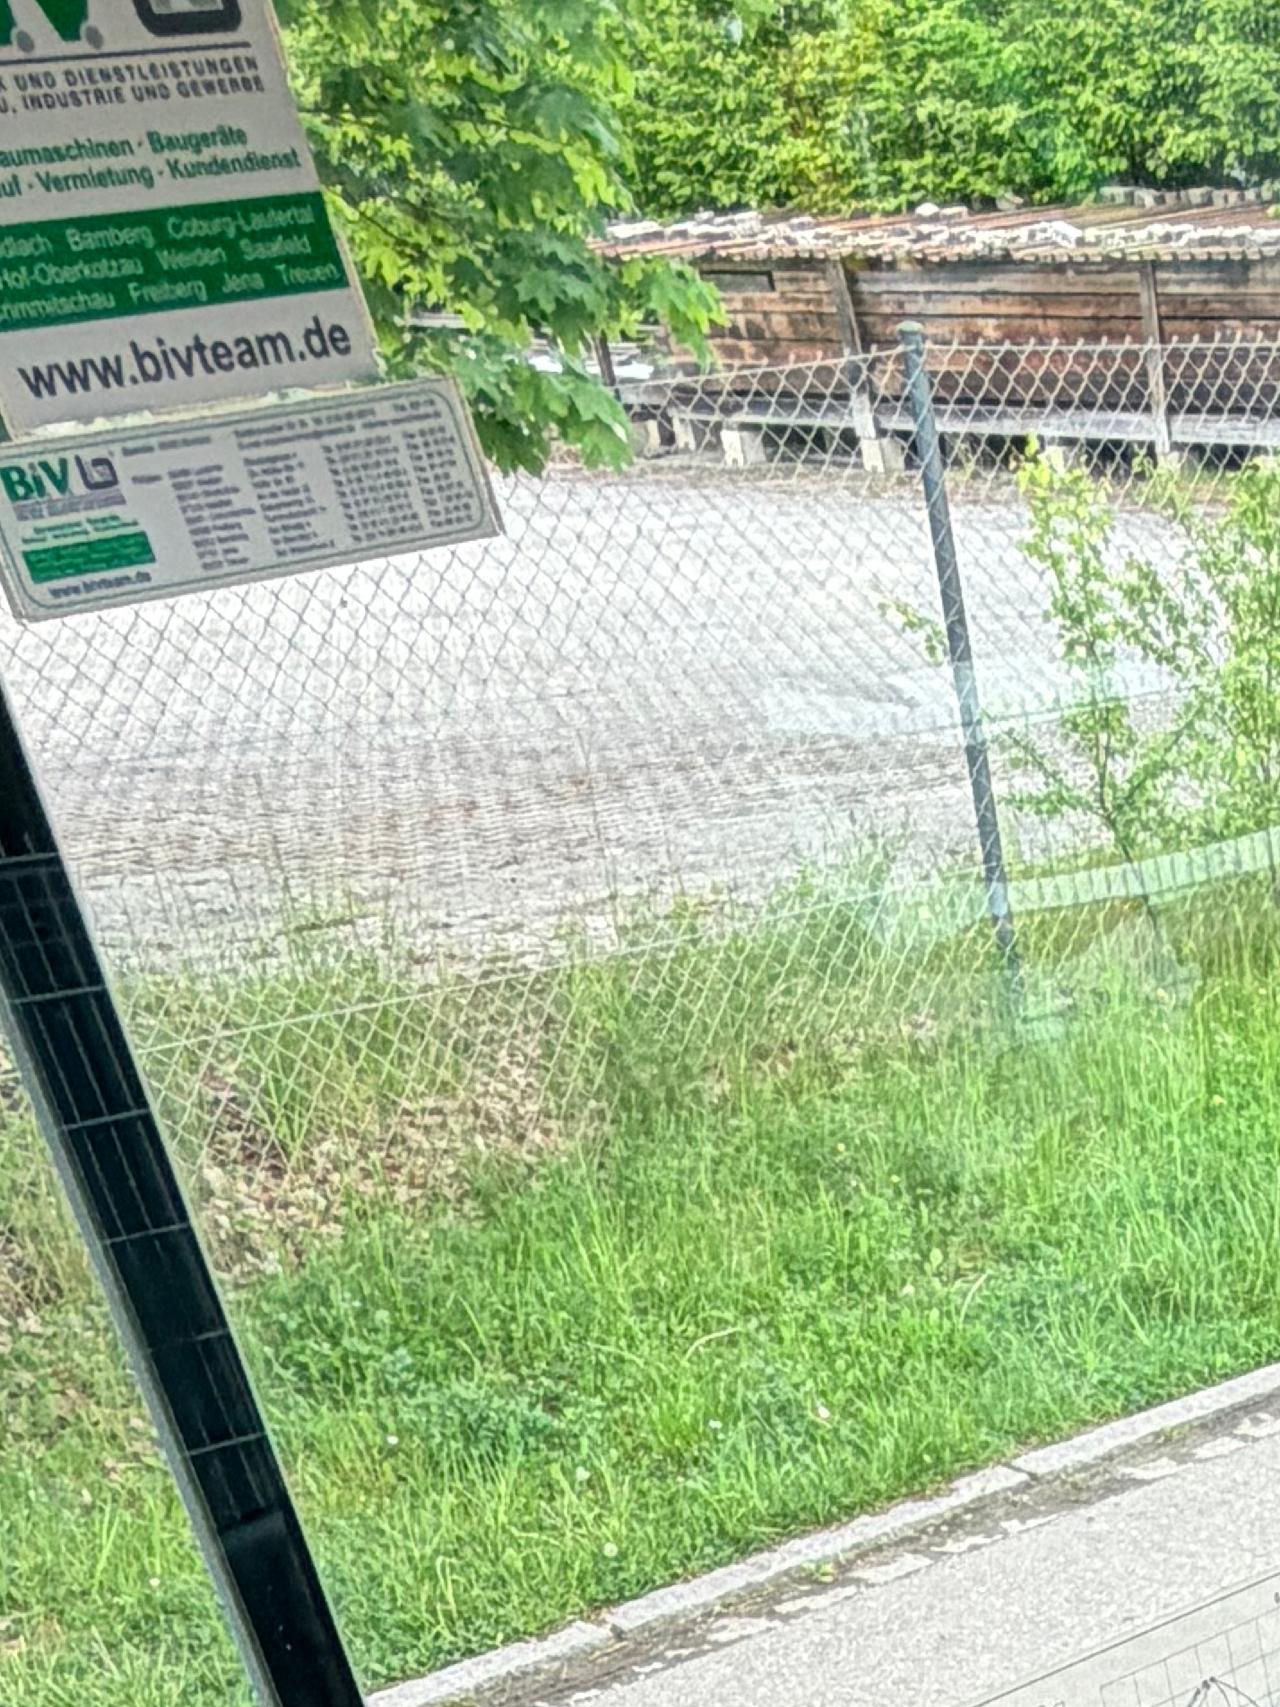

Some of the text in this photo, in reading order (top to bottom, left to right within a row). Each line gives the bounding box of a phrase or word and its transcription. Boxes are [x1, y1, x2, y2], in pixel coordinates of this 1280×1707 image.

[14, 70, 57, 92] UND
[64, 56, 259, 87] DIENSTLEISTUNGEN
[22, 85, 124, 110] INDUSTRIE
[131, 83, 171, 101] UND
[177, 74, 265, 98] GEWERBE
[146, 124, 248, 155] Baugeräte
[35, 164, 155, 192] Vermietung
[165, 148, 302, 180] Kundendienst
[18, 315, 352, 399] www.bivteam.de
